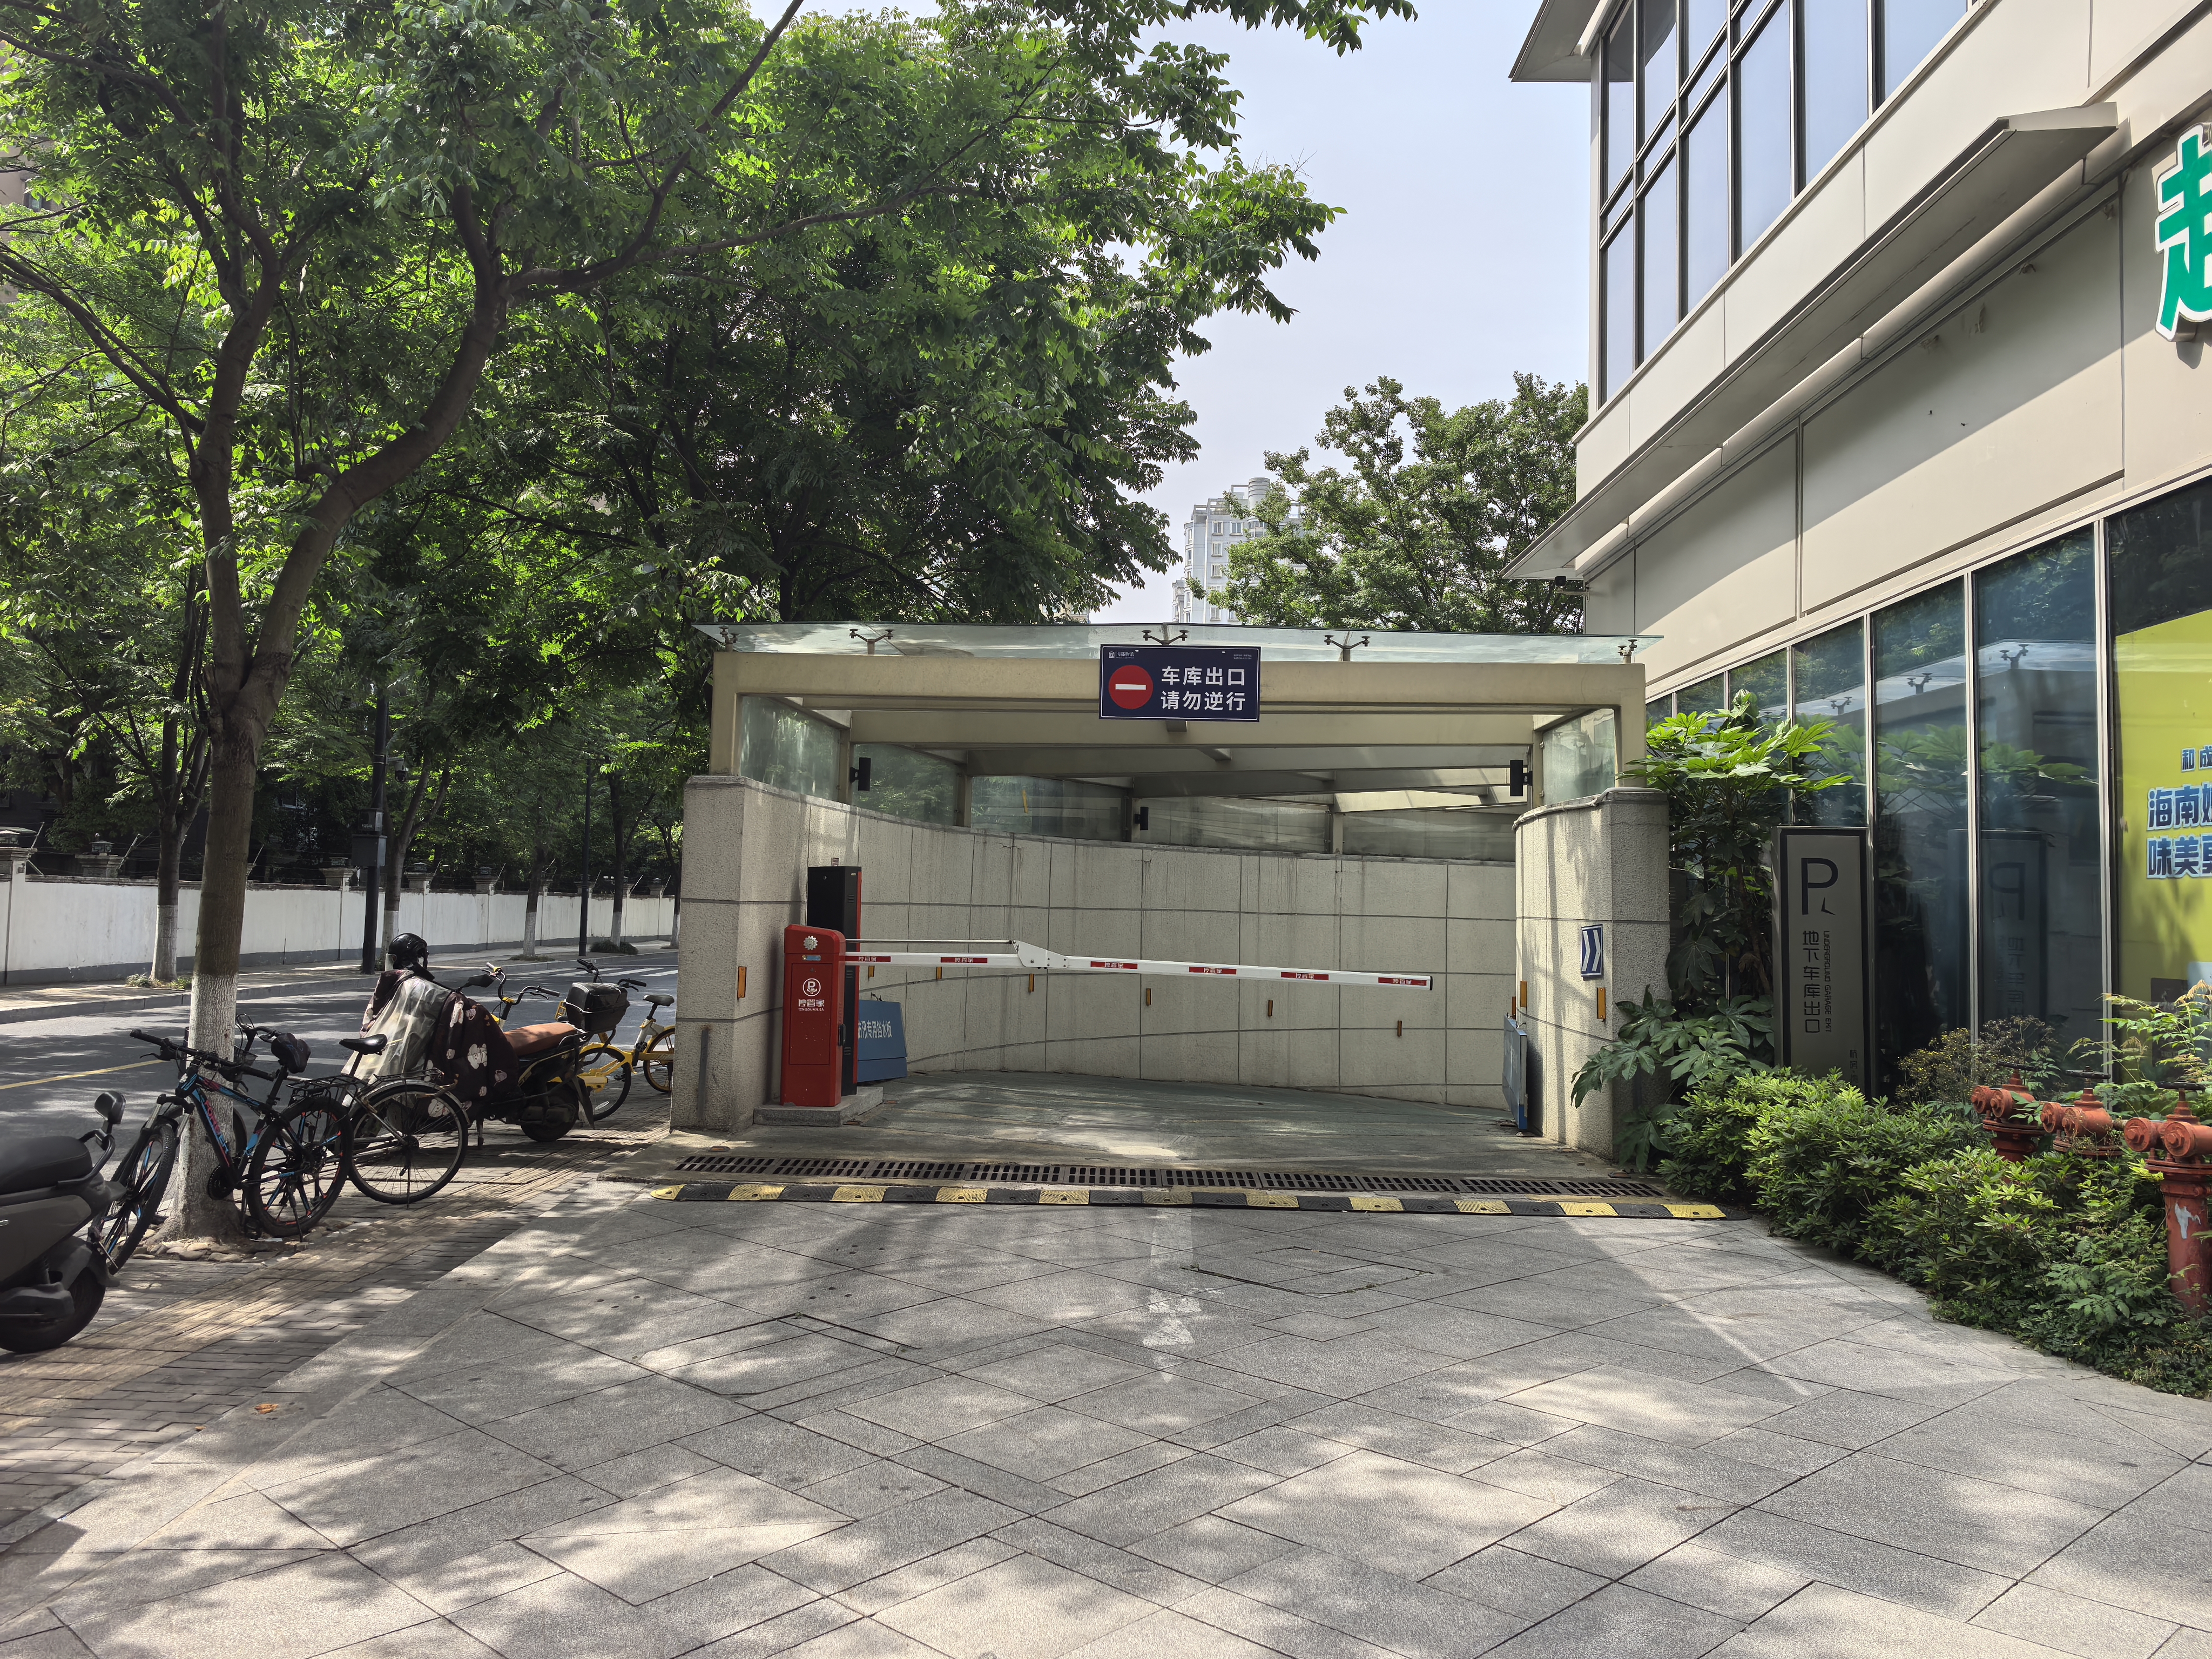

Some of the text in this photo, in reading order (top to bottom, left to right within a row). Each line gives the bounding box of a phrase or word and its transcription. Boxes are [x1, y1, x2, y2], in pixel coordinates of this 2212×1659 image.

[1161, 666, 1245, 686] 车库出口
[1161, 690, 1245, 711] 请勿逆行
[1801, 858, 1838, 915] P
[1803, 930, 1820, 1033] 地下车库出口
[1823, 930, 1831, 982] UNDERGROUND
